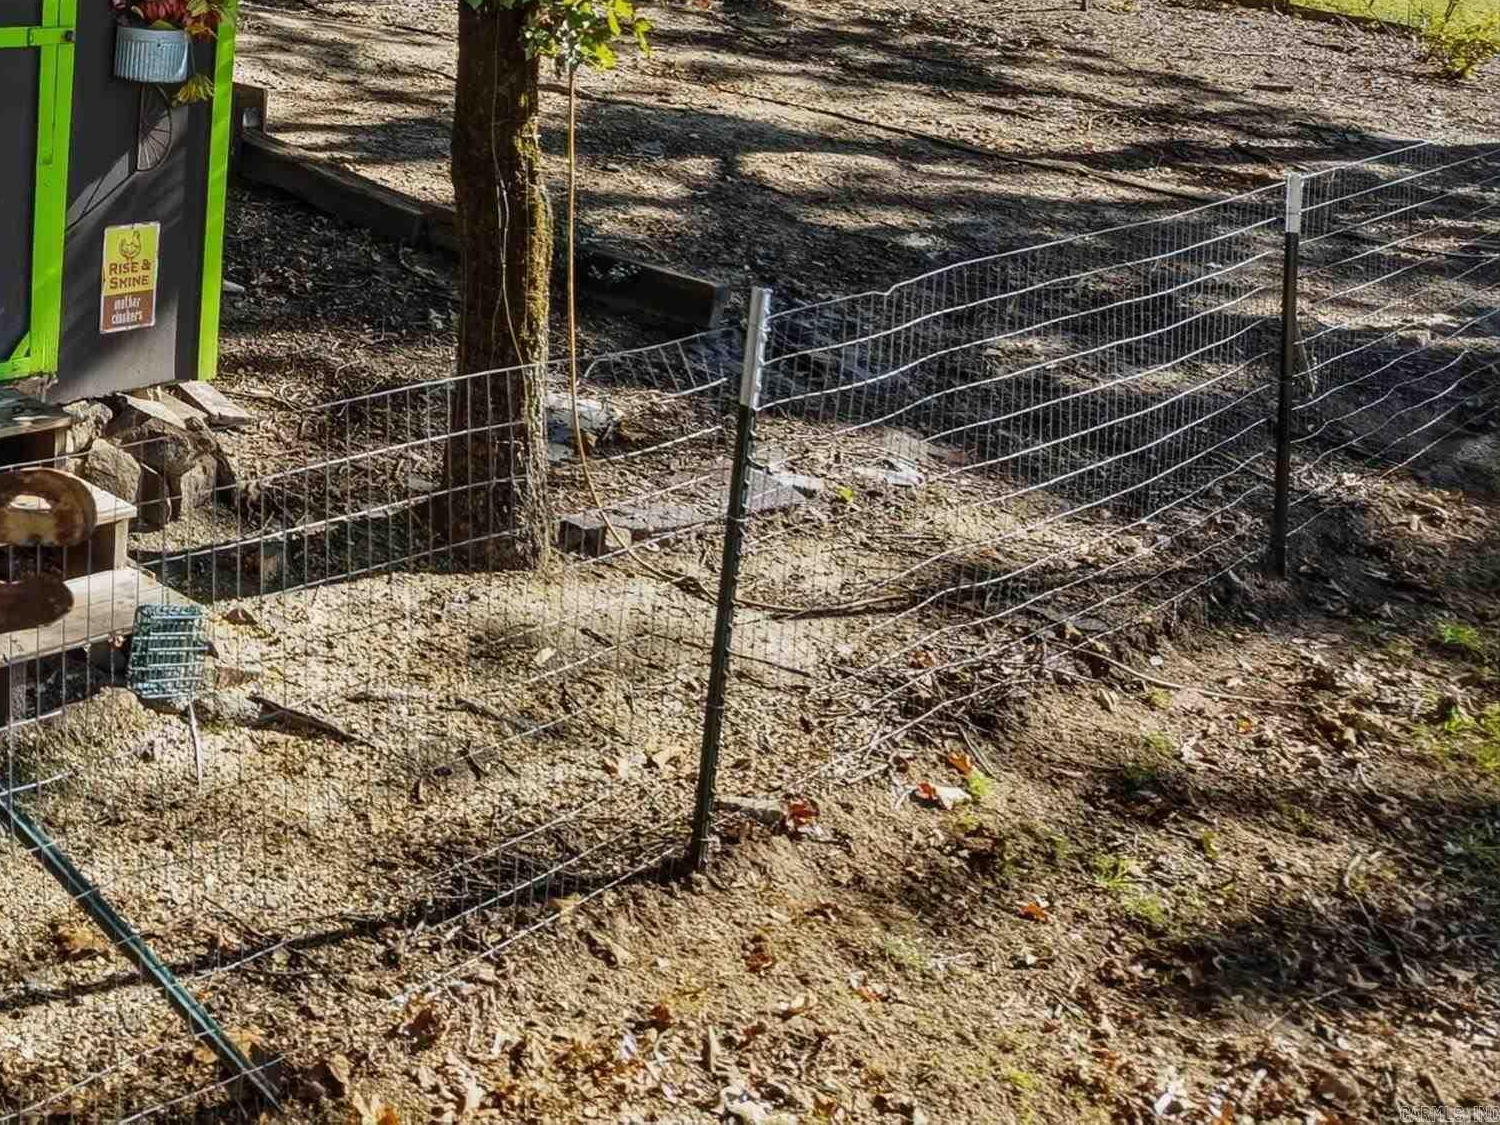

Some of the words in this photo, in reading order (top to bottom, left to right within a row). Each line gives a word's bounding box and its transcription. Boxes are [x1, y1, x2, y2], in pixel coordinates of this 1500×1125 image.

[108, 261, 139, 276] RISE
[141, 258, 151, 271] &
[109, 275, 149, 290] SHINE
